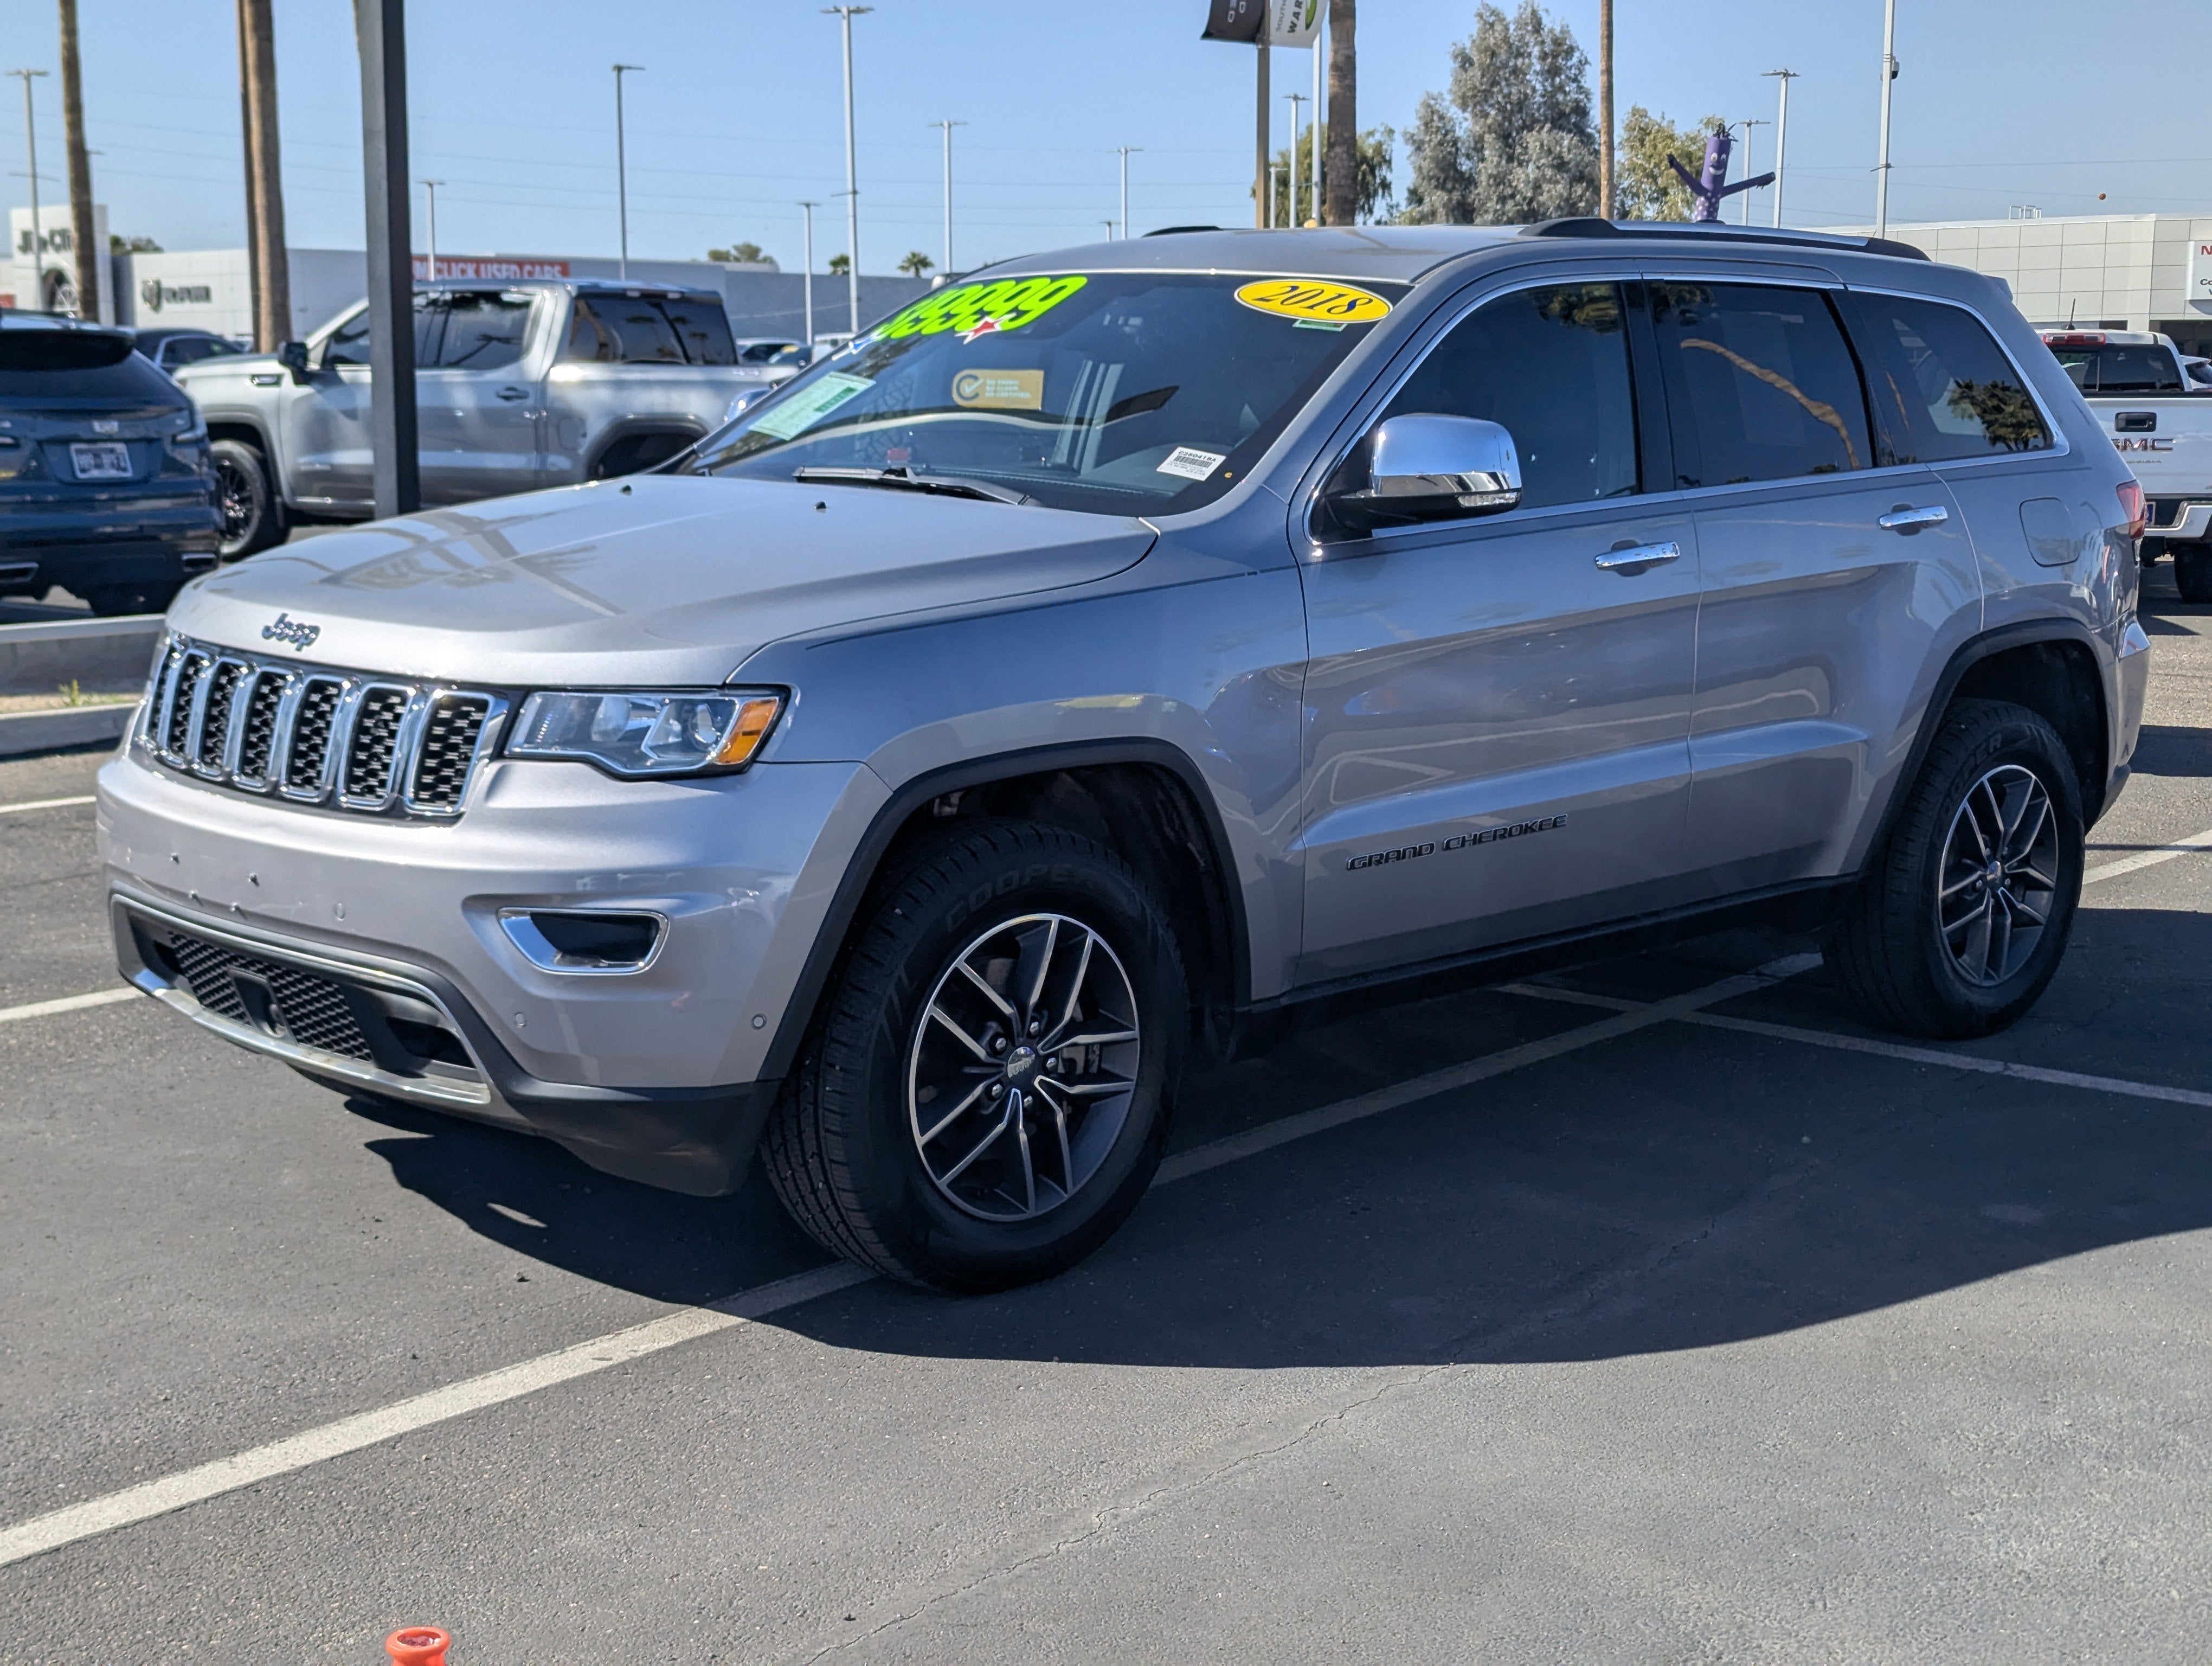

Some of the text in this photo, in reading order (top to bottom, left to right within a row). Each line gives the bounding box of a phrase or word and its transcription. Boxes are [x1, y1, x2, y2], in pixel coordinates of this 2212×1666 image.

[1252, 285, 1374, 315] 2018
[262, 613, 321, 652] Jeep
[1347, 814, 1568, 870] GRAND CHEROKEE
